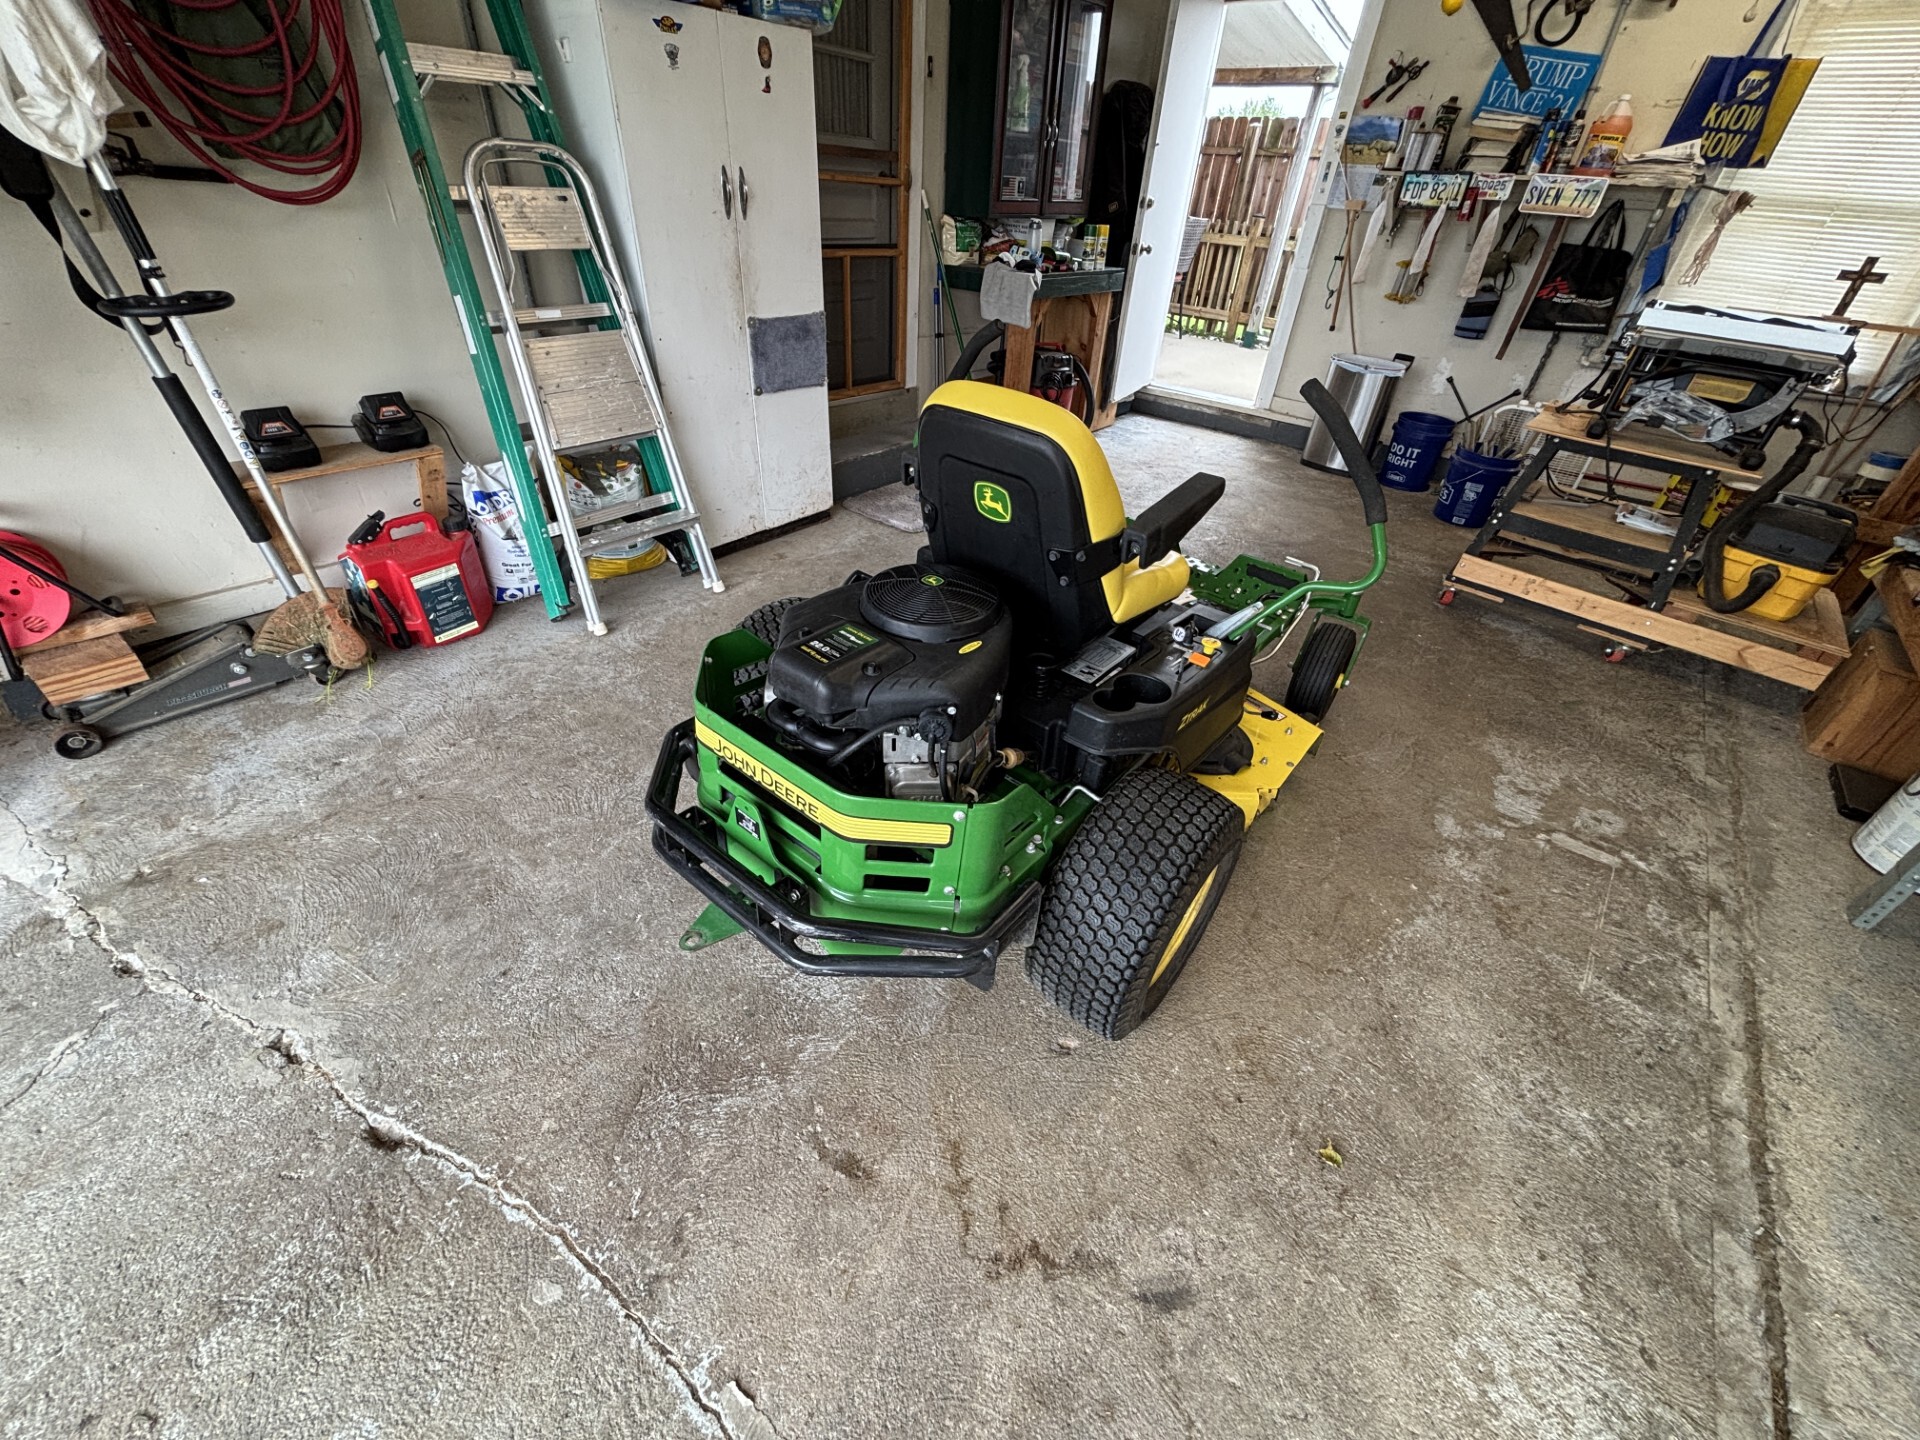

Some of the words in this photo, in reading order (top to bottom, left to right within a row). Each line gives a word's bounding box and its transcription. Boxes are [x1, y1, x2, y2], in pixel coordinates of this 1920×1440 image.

[1505, 54, 1587, 89] RUMP
[1487, 80, 1547, 114] VANCE
[1702, 102, 1763, 131] KNOW
[1701, 131, 1747, 158] HOW
[1402, 182, 1428, 200] FDP
[1430, 182, 1462, 201] 821
[1526, 186, 1564, 206] SVEN
[1569, 189, 1600, 208] 777
[1387, 453, 1417, 469] RIGHT
[1391, 442, 1405, 455] DO
[1406, 448, 1421, 459] IT
[713, 739, 757, 779] JOHN
[761, 767, 820, 820] DEERE
